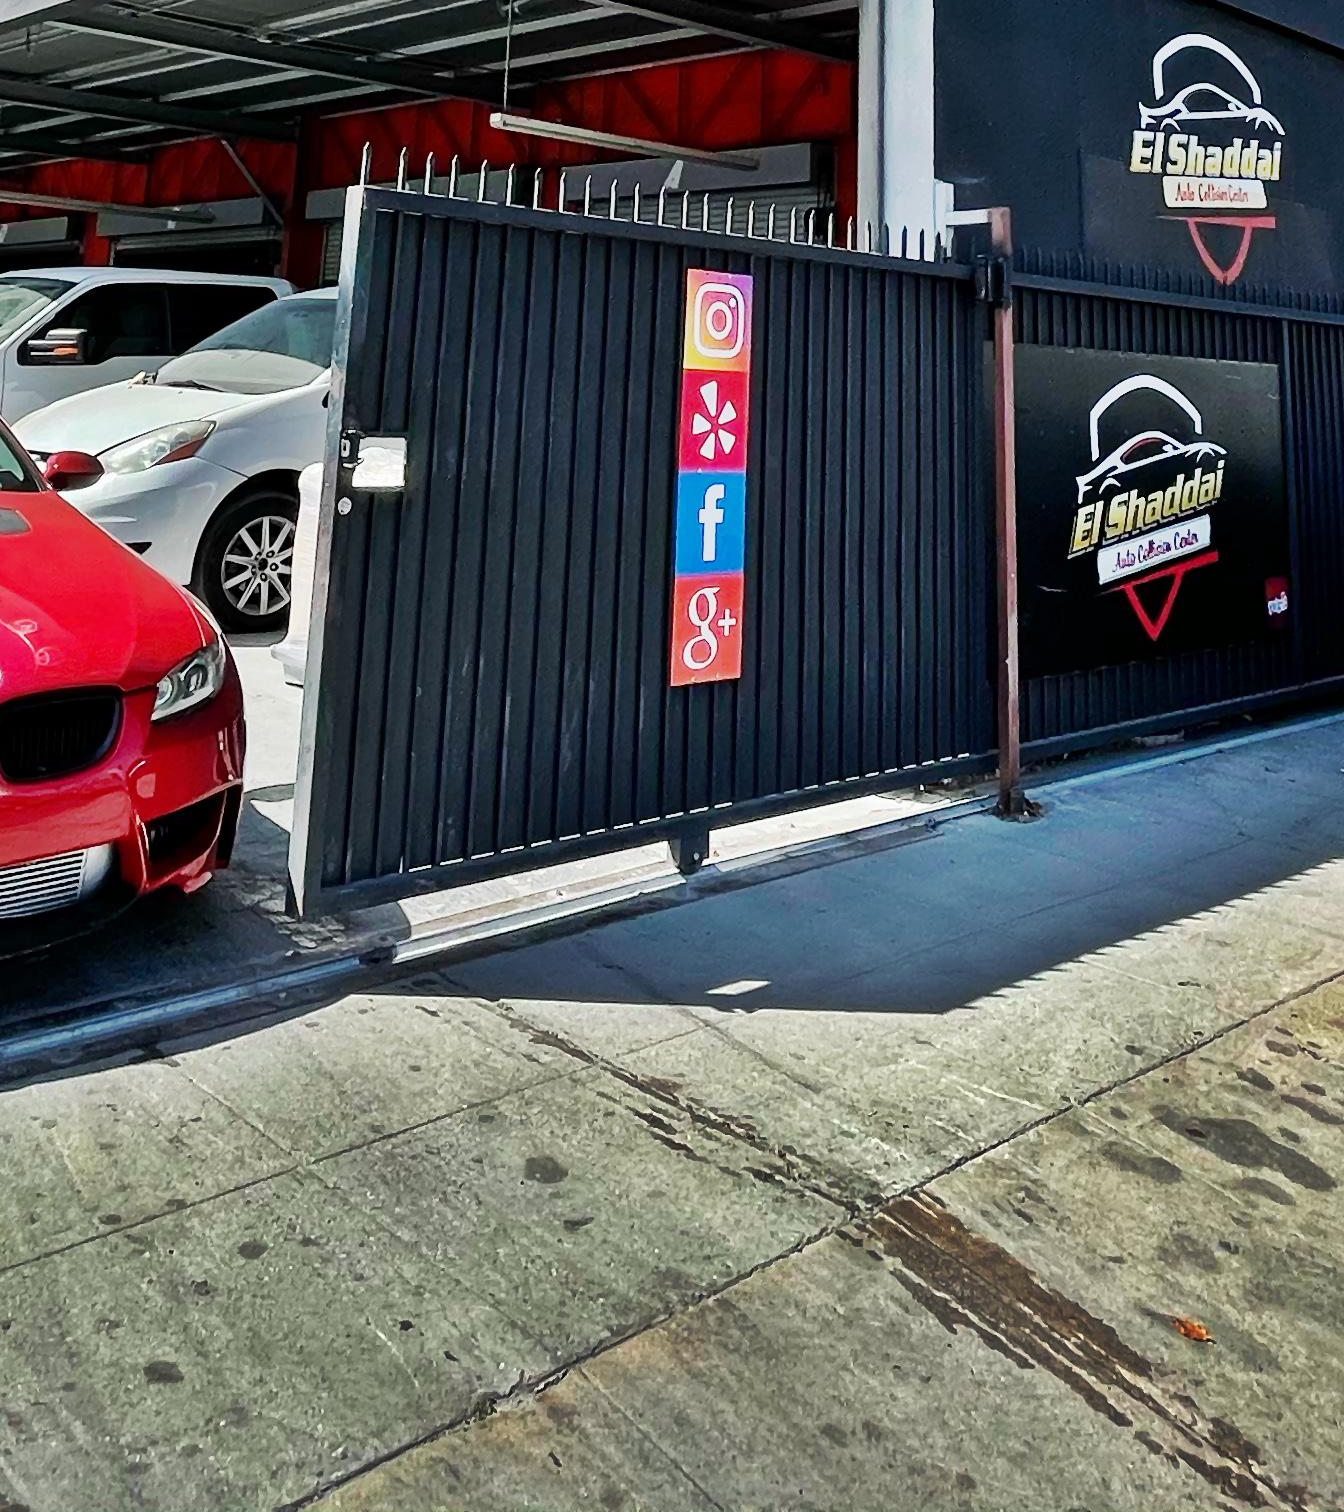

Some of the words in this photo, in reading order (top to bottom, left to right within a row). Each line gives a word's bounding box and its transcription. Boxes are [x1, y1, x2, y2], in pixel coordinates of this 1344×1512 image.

[1129, 129, 1165, 174] El
[1166, 133, 1282, 181] Shaddai
[1067, 500, 1104, 559] El
[1103, 459, 1226, 545] Shaddai
